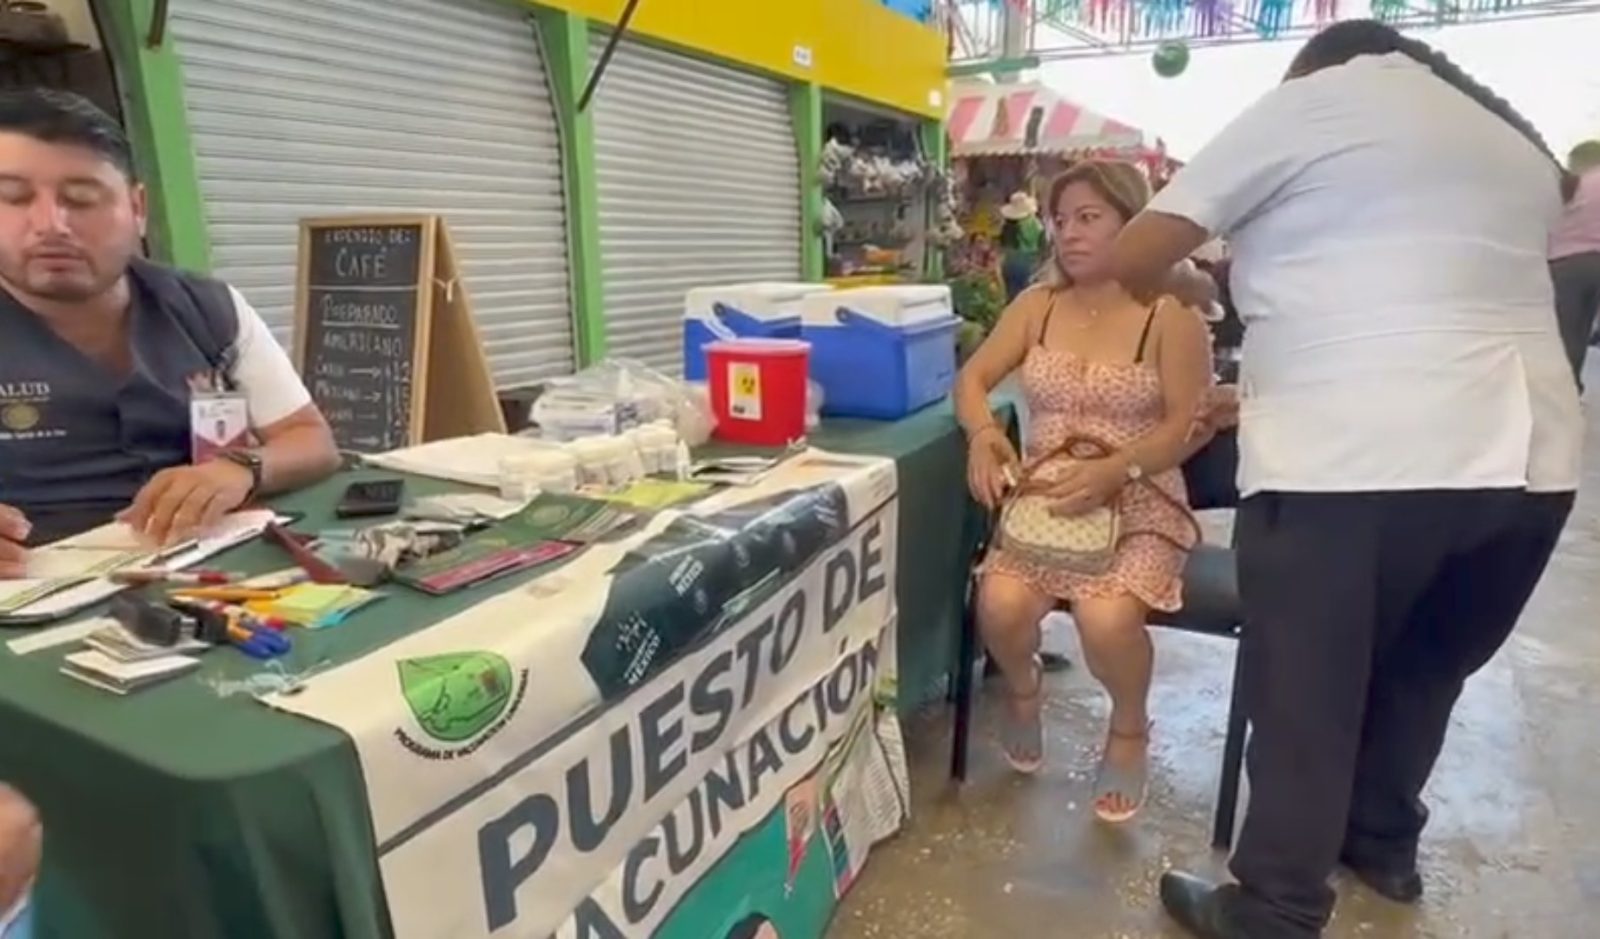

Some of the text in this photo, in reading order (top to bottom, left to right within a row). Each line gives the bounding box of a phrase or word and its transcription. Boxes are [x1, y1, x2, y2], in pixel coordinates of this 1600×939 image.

[336, 247, 387, 278] CAFÉ
[0, 382, 50, 397] ALUD
[477, 520, 887, 933] PUESTO DE
[544, 633, 877, 939] ACUNACIÓN
